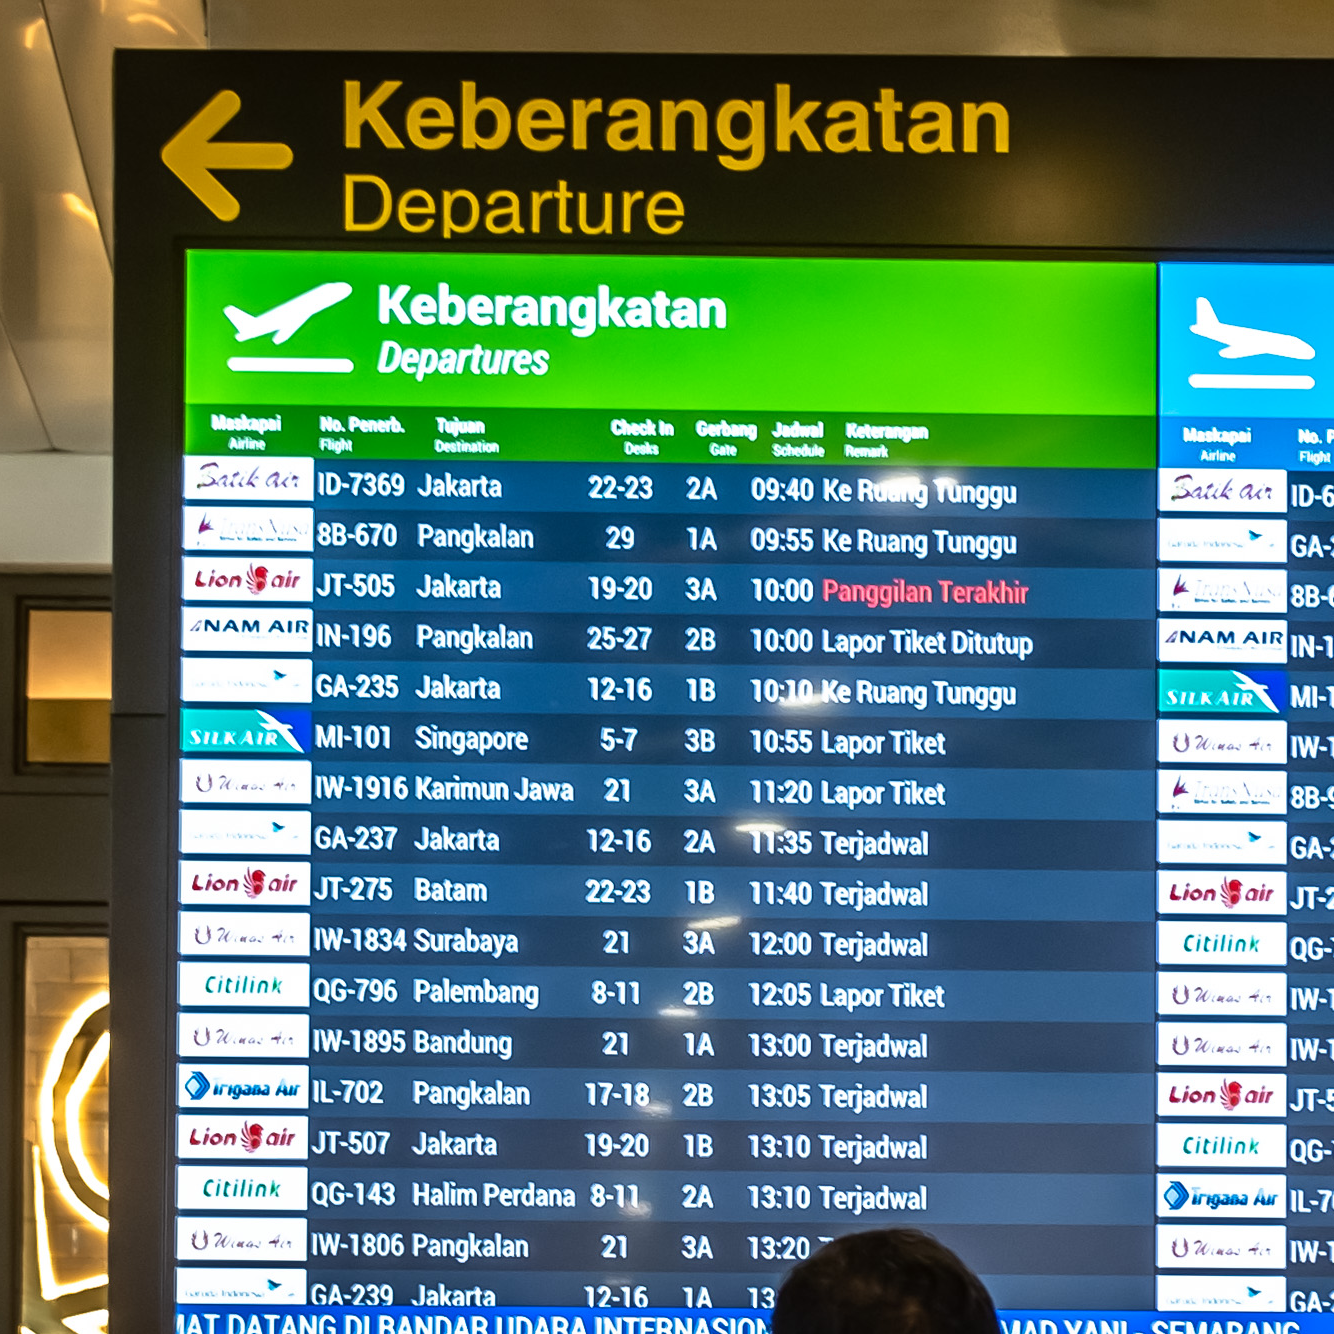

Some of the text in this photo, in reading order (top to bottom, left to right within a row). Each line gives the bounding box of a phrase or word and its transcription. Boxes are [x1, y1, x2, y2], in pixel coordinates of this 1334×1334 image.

[344, 80, 1010, 172] Keberangkatan
[344, 174, 685, 239] Departure
[378, 282, 727, 338] Keberangkatan
[377, 340, 550, 382] Departures
[211, 413, 282, 435] Maskapai
[319, 415, 406, 433] No. Penerb.
[435, 416, 486, 438] Tujuan
[610, 418, 675, 437] Check In
[696, 419, 758, 442] Gerbang
[771, 420, 824, 438] Jadwal
[846, 422, 929, 443] Keterangan
[229, 436, 266, 451] Airline
[319, 437, 353, 455] Flight
[434, 439, 500, 453] Destination
[1182, 426, 1252, 447] Maskapai
[1298, 428, 1323, 445] No.
[624, 441, 660, 456] Desks
[709, 442, 738, 457] Gate
[772, 443, 825, 458] Schedule
[845, 444, 889, 458] Remark
[1200, 449, 1236, 462] Airline
[1299, 450, 1331, 466] Flight
[318, 472, 405, 497] ID-7369
[417, 472, 502, 498] Jakarta
[588, 474, 653, 500] 22-23
[686, 476, 718, 501] 2A
[751, 477, 814, 502] 09:40
[823, 478, 852, 502] Ke
[857, 475, 929, 509] Ruang
[932, 475, 1017, 510] Tunggu
[194, 570, 1030, 609] Lion air JT-505 Jakarta 19-20 3A 10:00 Panggilan Terakhir
[203, 619, 1034, 661] NAM AIR IN-196 Pangkalan 25-27 2B 10:00 Lapor Tiket Ditutup
[315, 724, 391, 749] MI-101
[415, 725, 529, 756] Singapore
[600, 727, 638, 752] 5-7
[684, 728, 716, 753] 3B
[750, 729, 813, 754] 10:55
[821, 729, 886, 760] Lapor
[889, 729, 946, 755] Tiket
[1182, 933, 1260, 955] Citilink
[204, 974, 946, 1013] Citilink QG-796 Palembang 8-11 2B 12:05 Lapor Tiket
[313, 1079, 384, 1104] IL-702
[413, 1079, 530, 1111] Pangkalan
[584, 1082, 650, 1107] 17-18
[683, 1082, 714, 1107] 2B
[748, 1083, 811, 1108] 13:05
[819, 1083, 928, 1114] Terjadwal
[1169, 1085, 1215, 1105] Lion
[1245, 1087, 1274, 1105] air
